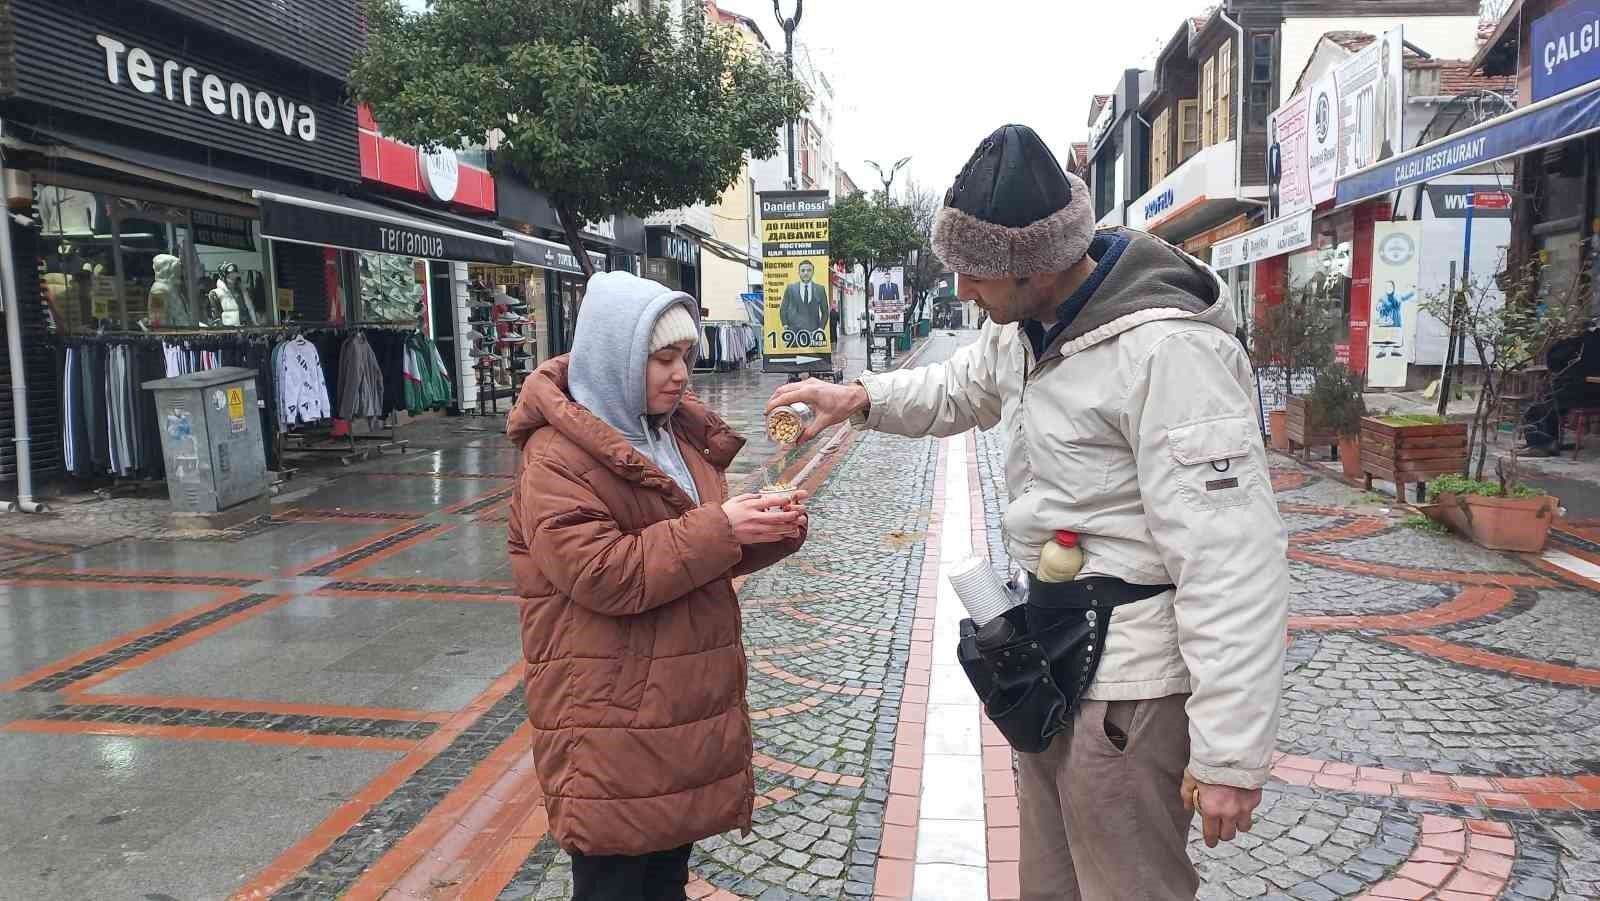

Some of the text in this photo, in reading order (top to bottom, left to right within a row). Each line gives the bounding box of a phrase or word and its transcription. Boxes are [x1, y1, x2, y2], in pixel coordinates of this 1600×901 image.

[1425, 137, 1486, 172] RESTAURANT
[763, 200, 825, 212] Daniel Rossi
[765, 222, 779, 231] ДО
